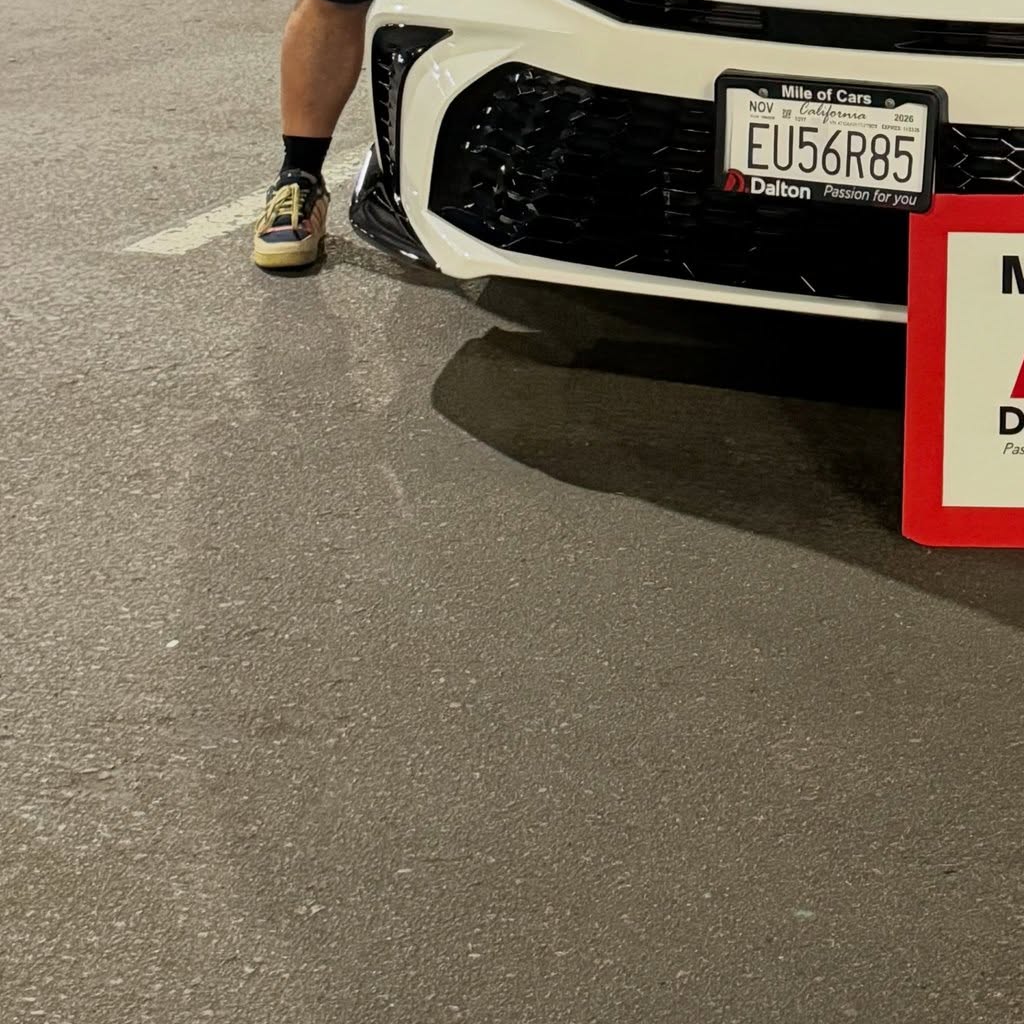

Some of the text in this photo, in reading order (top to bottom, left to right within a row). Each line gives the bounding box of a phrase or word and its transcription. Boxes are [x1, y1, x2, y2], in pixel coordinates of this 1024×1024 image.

[781, 84, 873, 105] Mile of Cars
[749, 100, 774, 114] NOV
[799, 101, 868, 125] California
[893, 113, 914, 124] 2026
[747, 122, 915, 183] EU56R85
[750, 178, 918, 207] Dalton Passion for you
